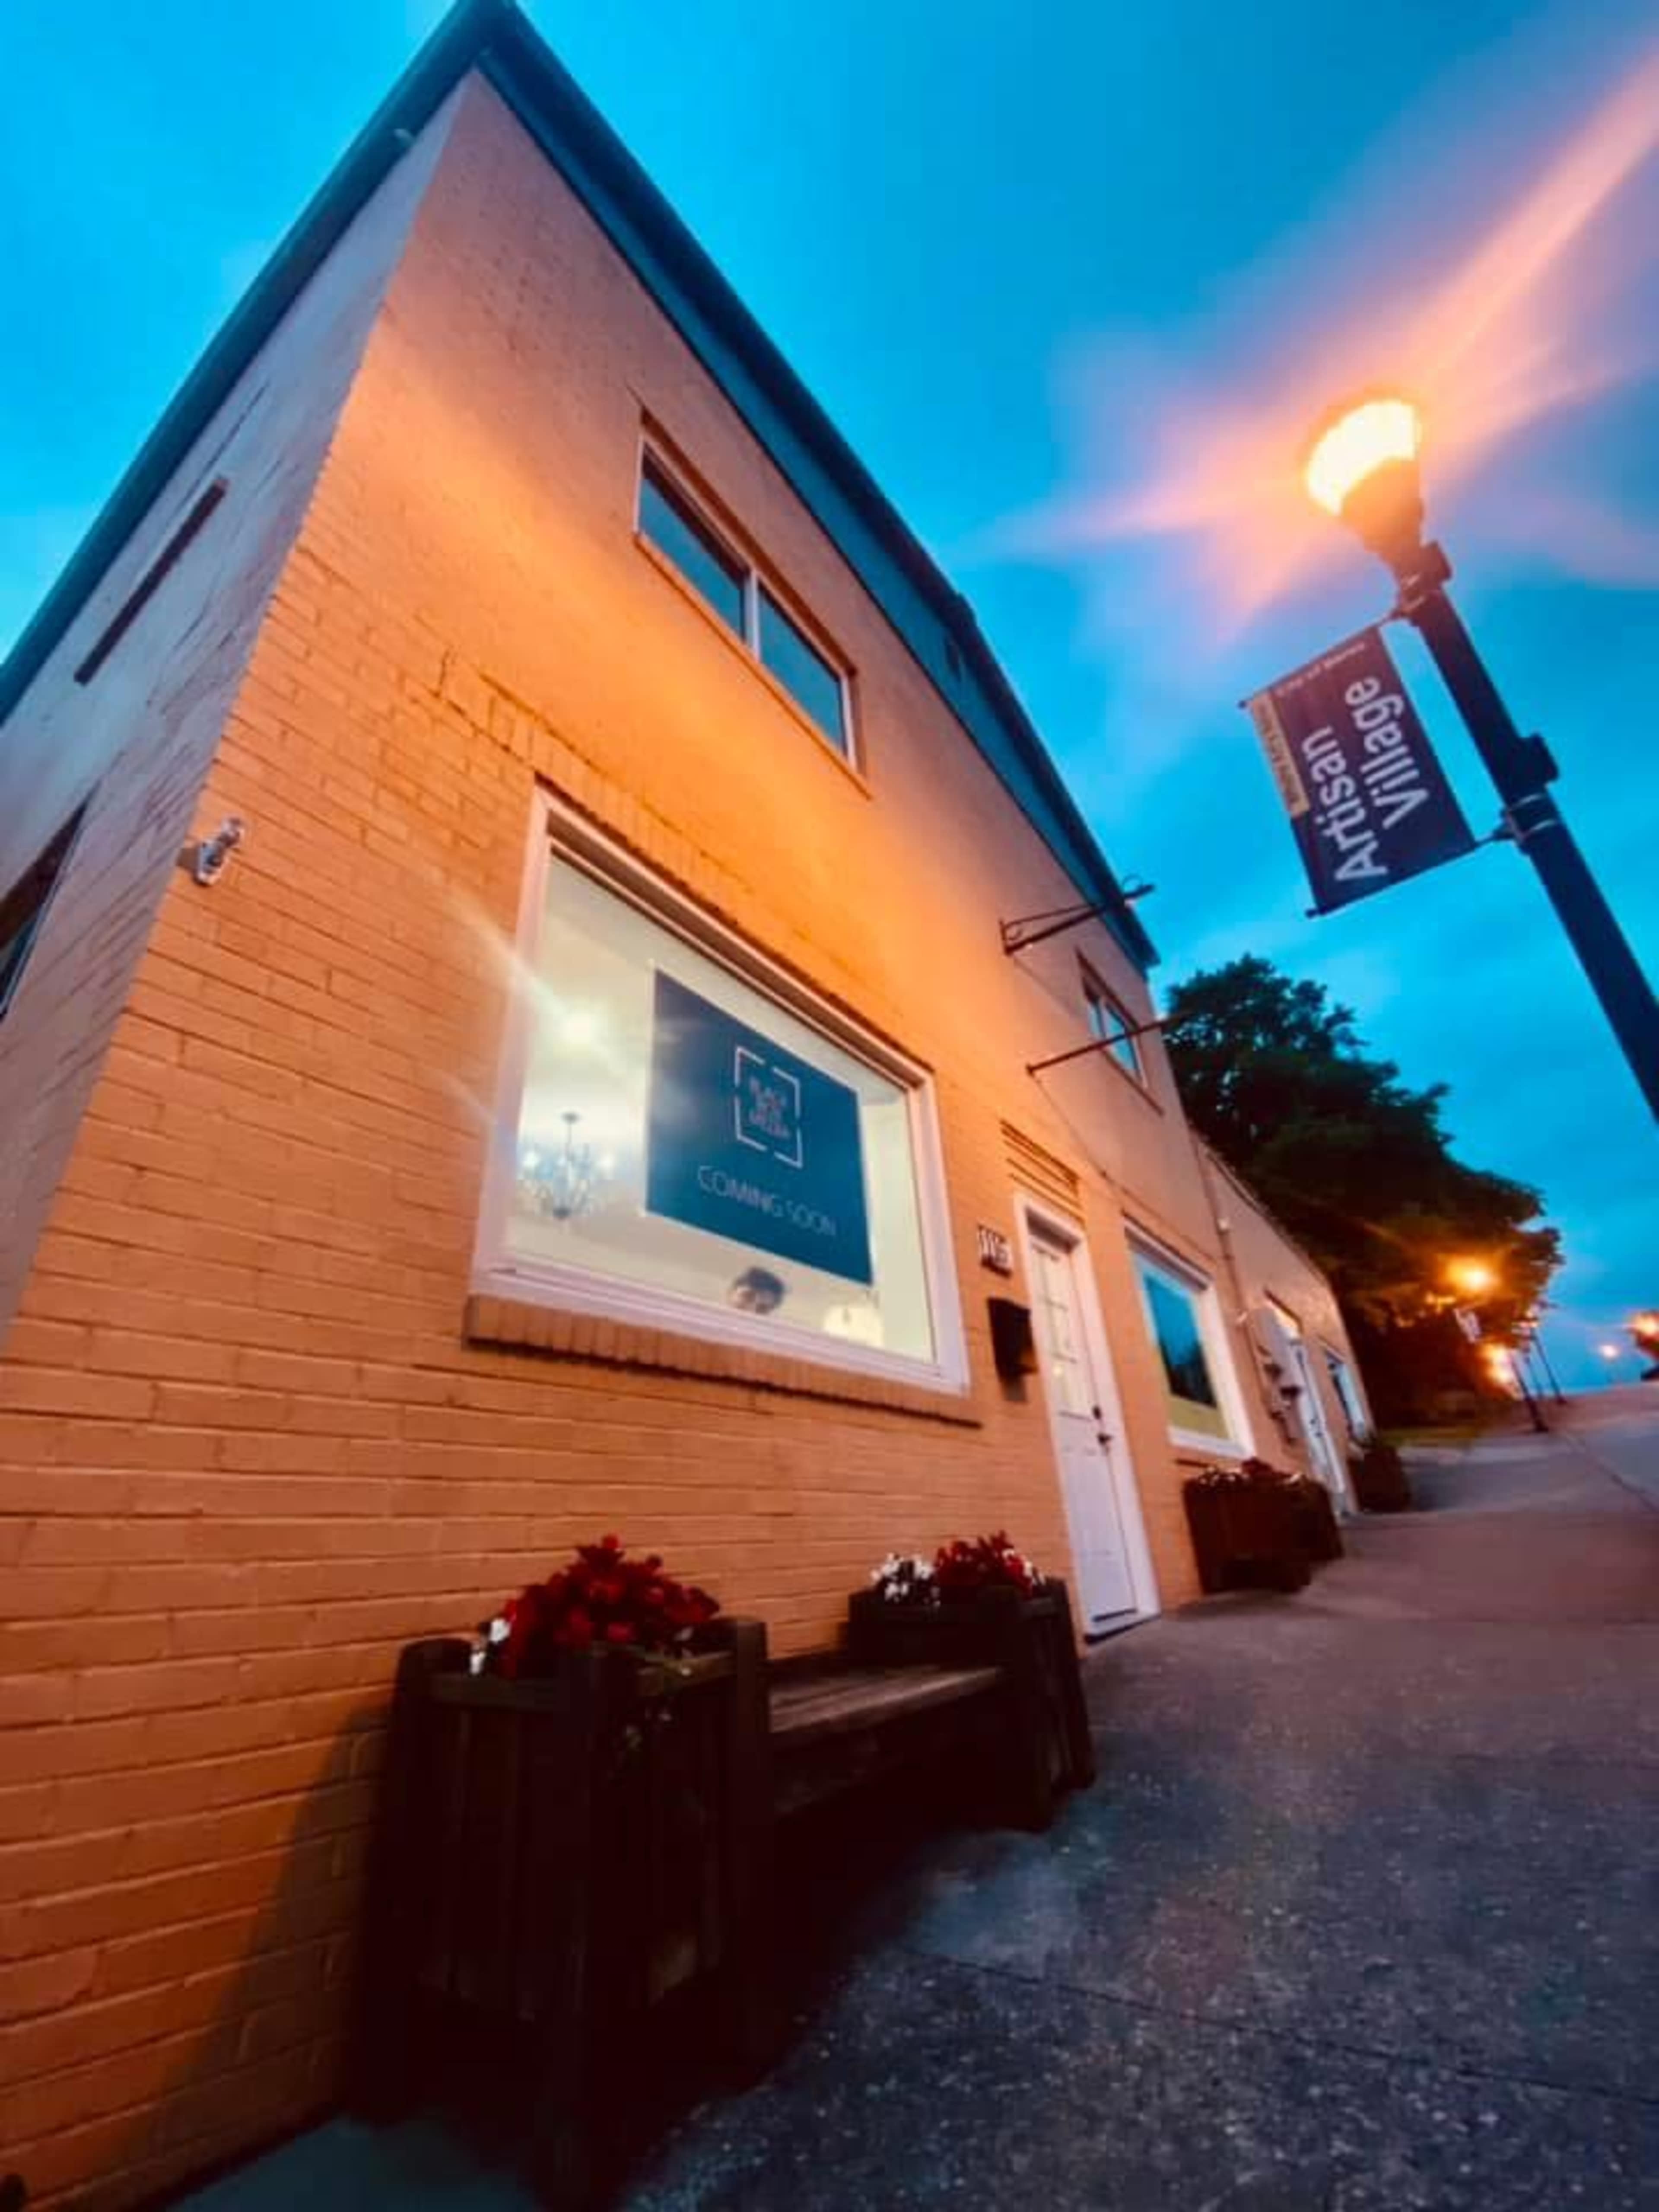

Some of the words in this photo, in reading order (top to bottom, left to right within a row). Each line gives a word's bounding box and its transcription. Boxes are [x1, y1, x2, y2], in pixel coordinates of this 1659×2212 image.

[1301, 725, 1388, 881] Artisan
[1344, 677, 1428, 830] Village
[698, 1166, 784, 1217] COMING
[786, 1199, 837, 1236] SOON
